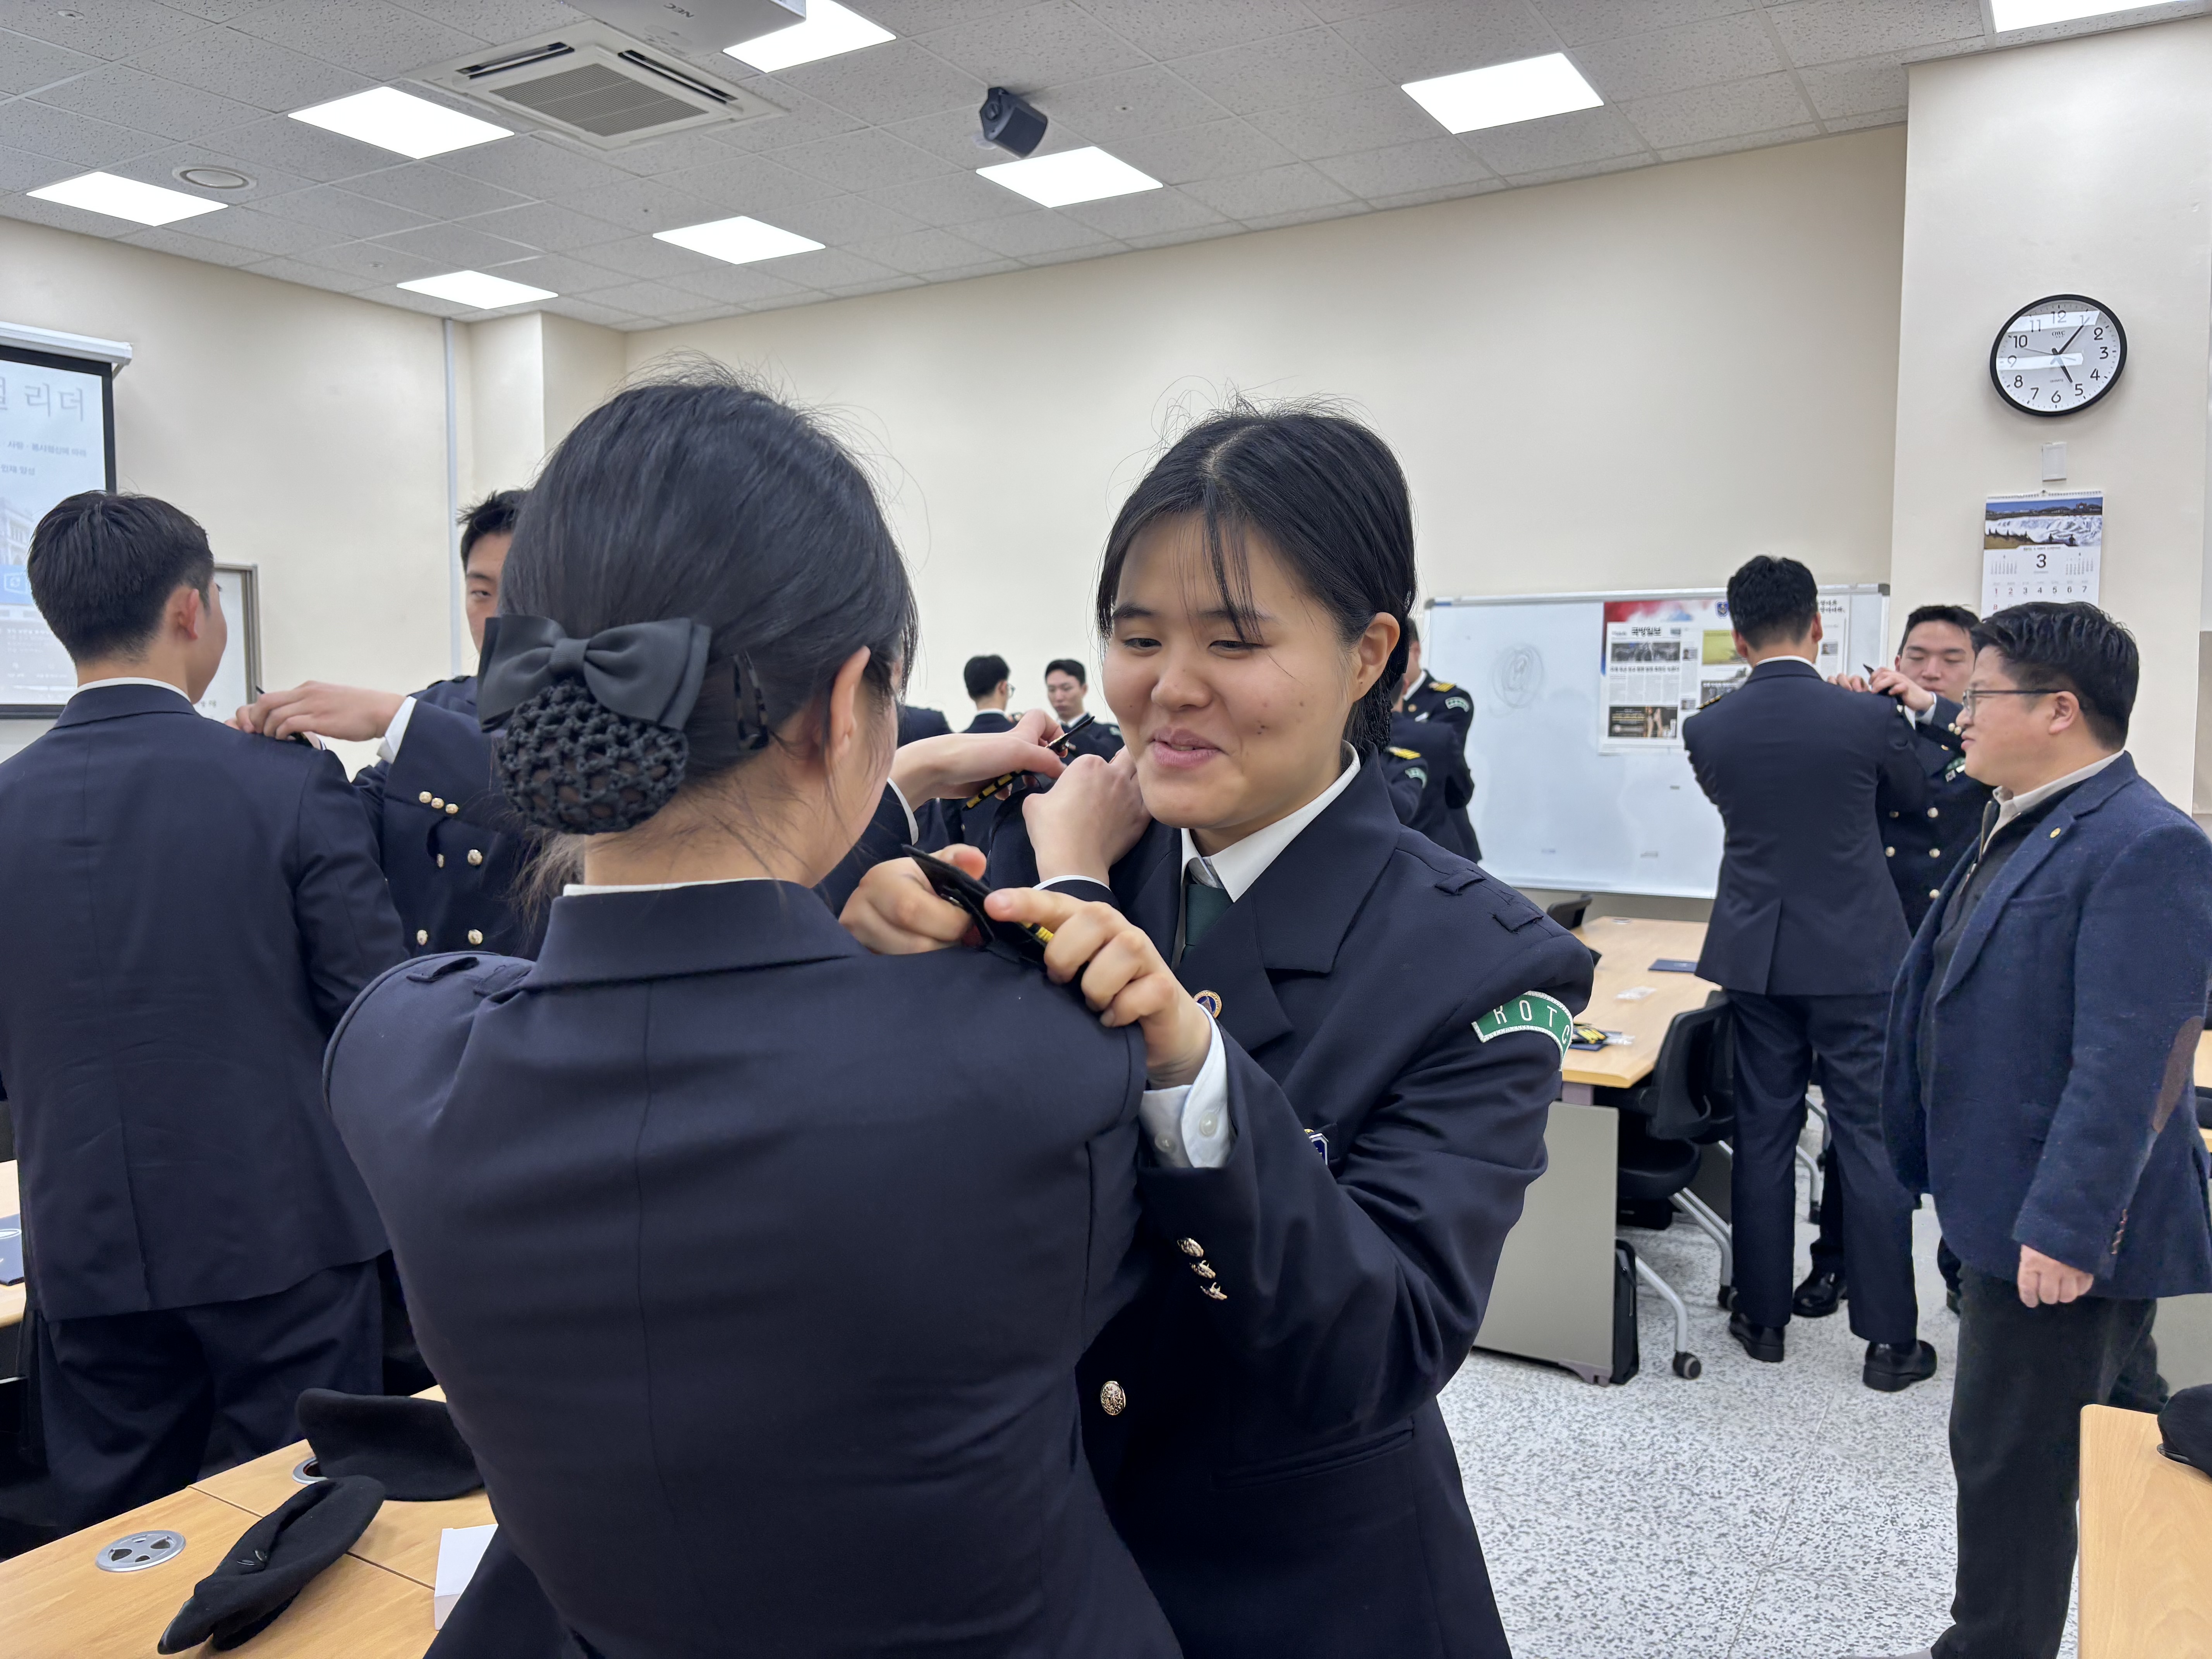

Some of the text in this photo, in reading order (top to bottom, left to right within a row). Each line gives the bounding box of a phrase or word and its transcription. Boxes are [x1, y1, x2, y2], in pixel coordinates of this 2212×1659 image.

[663, 3, 694, 18] NEC
[2051, 310, 2066, 324] 12
[2030, 319, 2041, 333] 11
[2094, 327, 2103, 340] 2
[2013, 335, 2027, 348] 10
[2099, 347, 2109, 359] 3
[2008, 355, 2017, 368] 9
[2090, 368, 2100, 381] 4
[2014, 375, 2023, 388] 8
[2030, 387, 2039, 400] 7
[2075, 383, 2083, 396] 5
[24, 382, 83, 422] 리더
[2051, 390, 2061, 403] 6
[2036, 553, 2047, 568] 3
[2023, 587, 2027, 595] 3
[1631, 626, 1661, 637] 국방일보
[1493, 1000, 1570, 1045] ROTC
